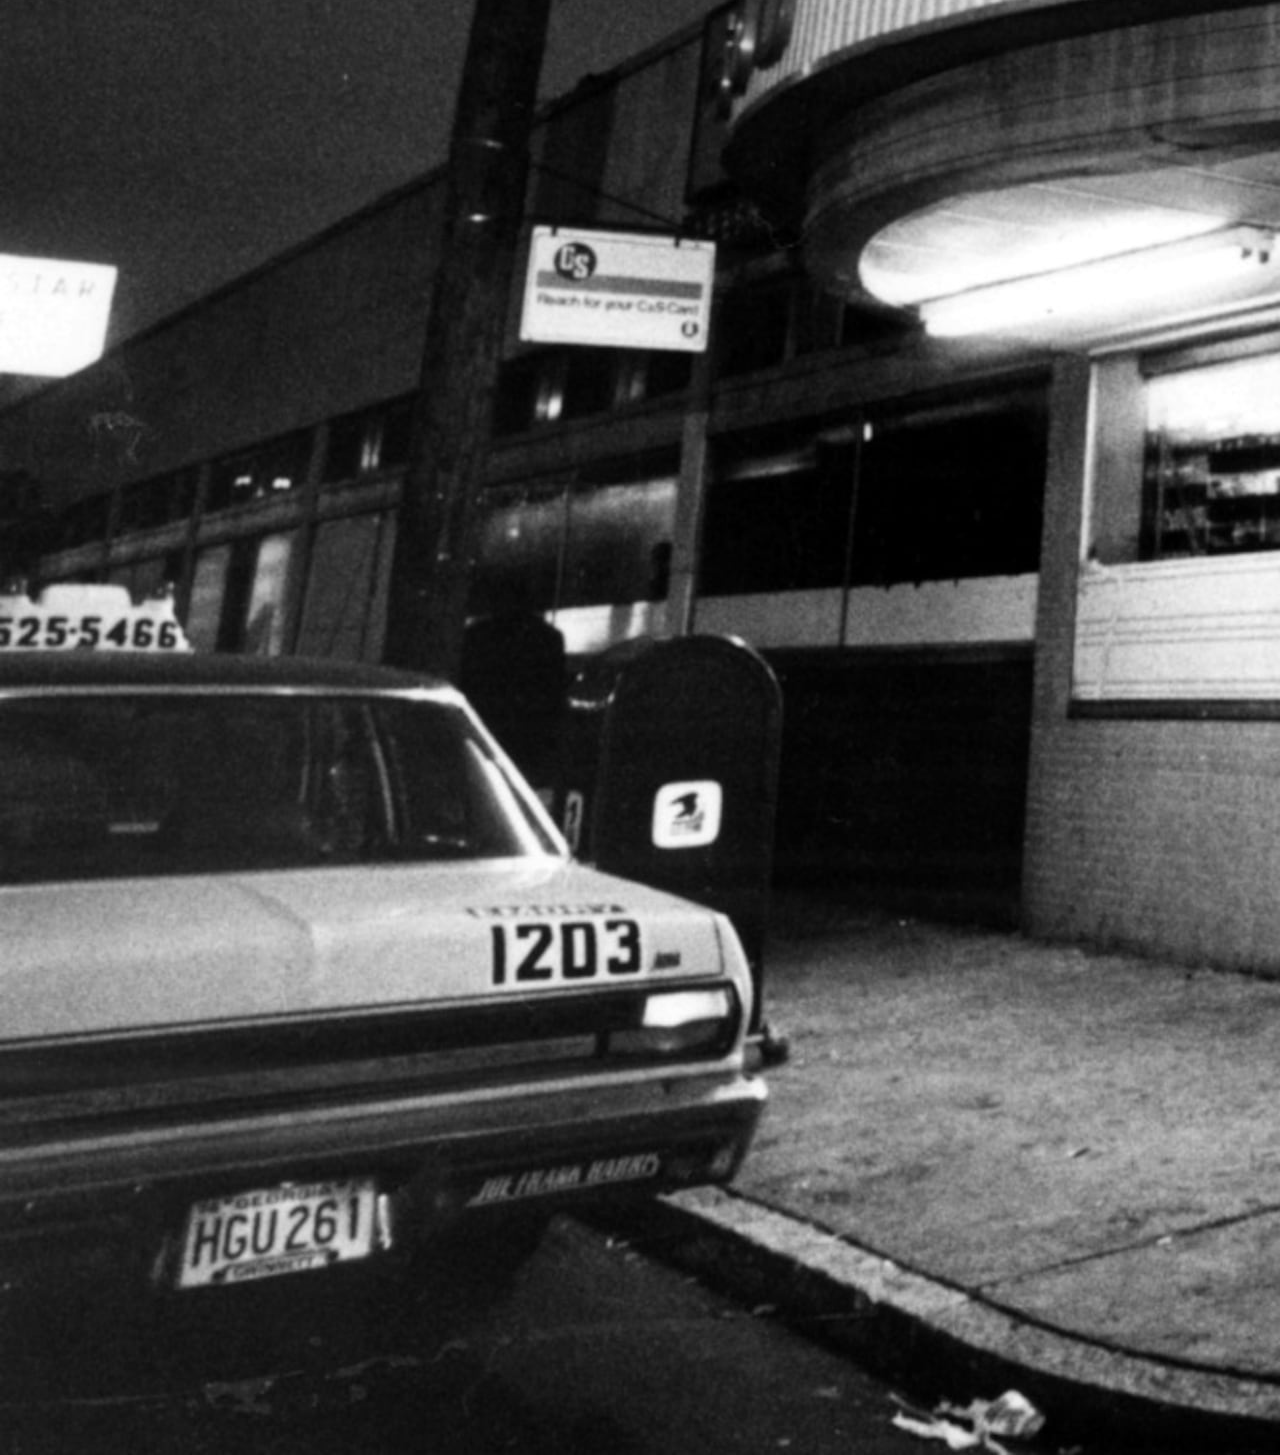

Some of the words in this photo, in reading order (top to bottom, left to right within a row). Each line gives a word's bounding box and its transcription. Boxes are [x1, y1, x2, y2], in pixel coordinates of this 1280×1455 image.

[537, 294, 581, 307] Reach
[584, 297, 600, 309] for
[604, 300, 633, 313] your
[491, 919, 642, 984] 1203
[191, 1208, 279, 1268] HGU
[284, 1196, 359, 1251] 261
